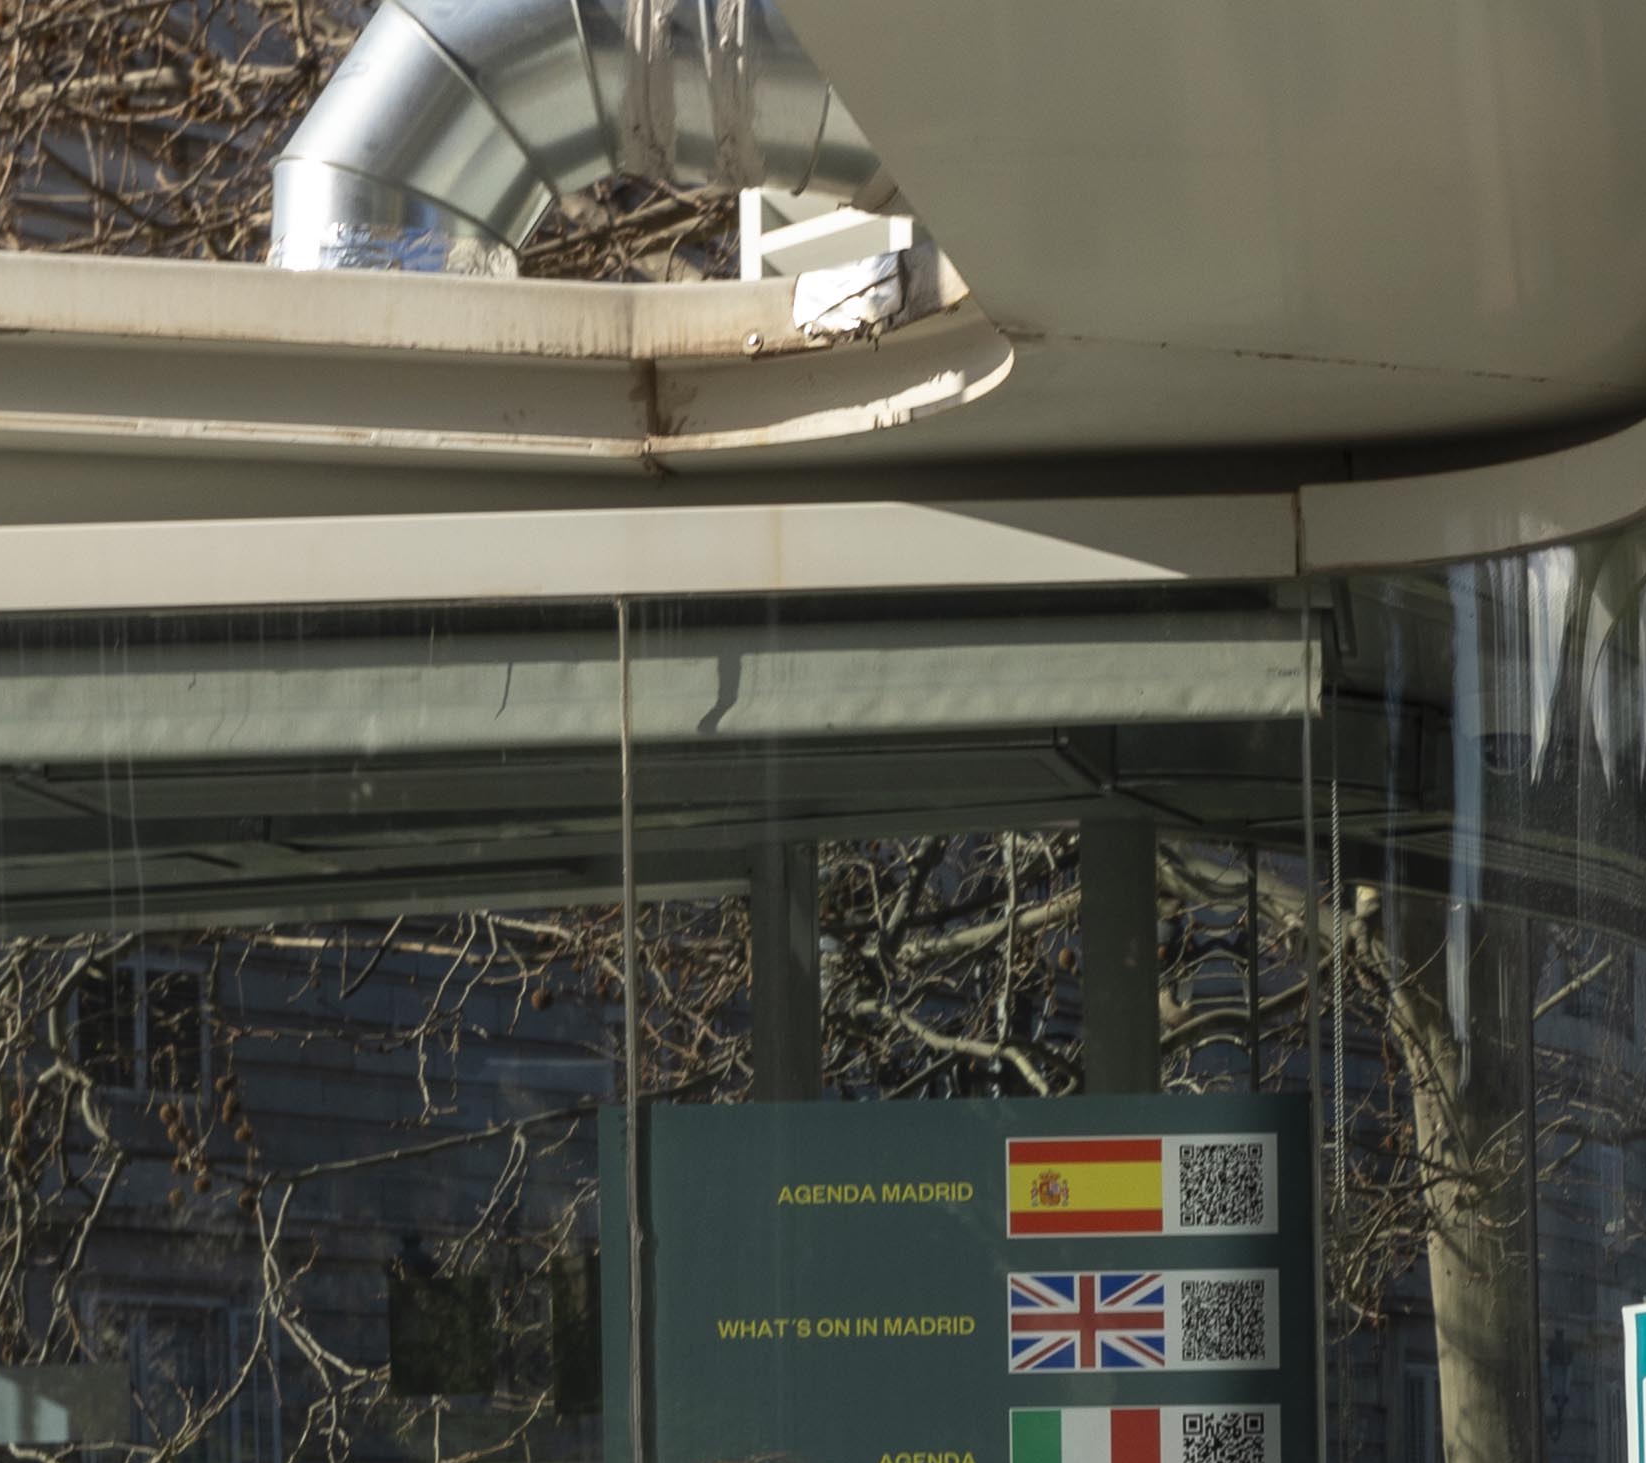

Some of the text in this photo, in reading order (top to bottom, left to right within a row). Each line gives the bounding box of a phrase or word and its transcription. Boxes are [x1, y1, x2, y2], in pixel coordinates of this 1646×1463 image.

[778, 1182, 973, 1204] AGENDA MADRID
[815, 1317, 851, 1338] ON
[855, 1316, 879, 1337] IN
[882, 1315, 977, 1337] MADRID
